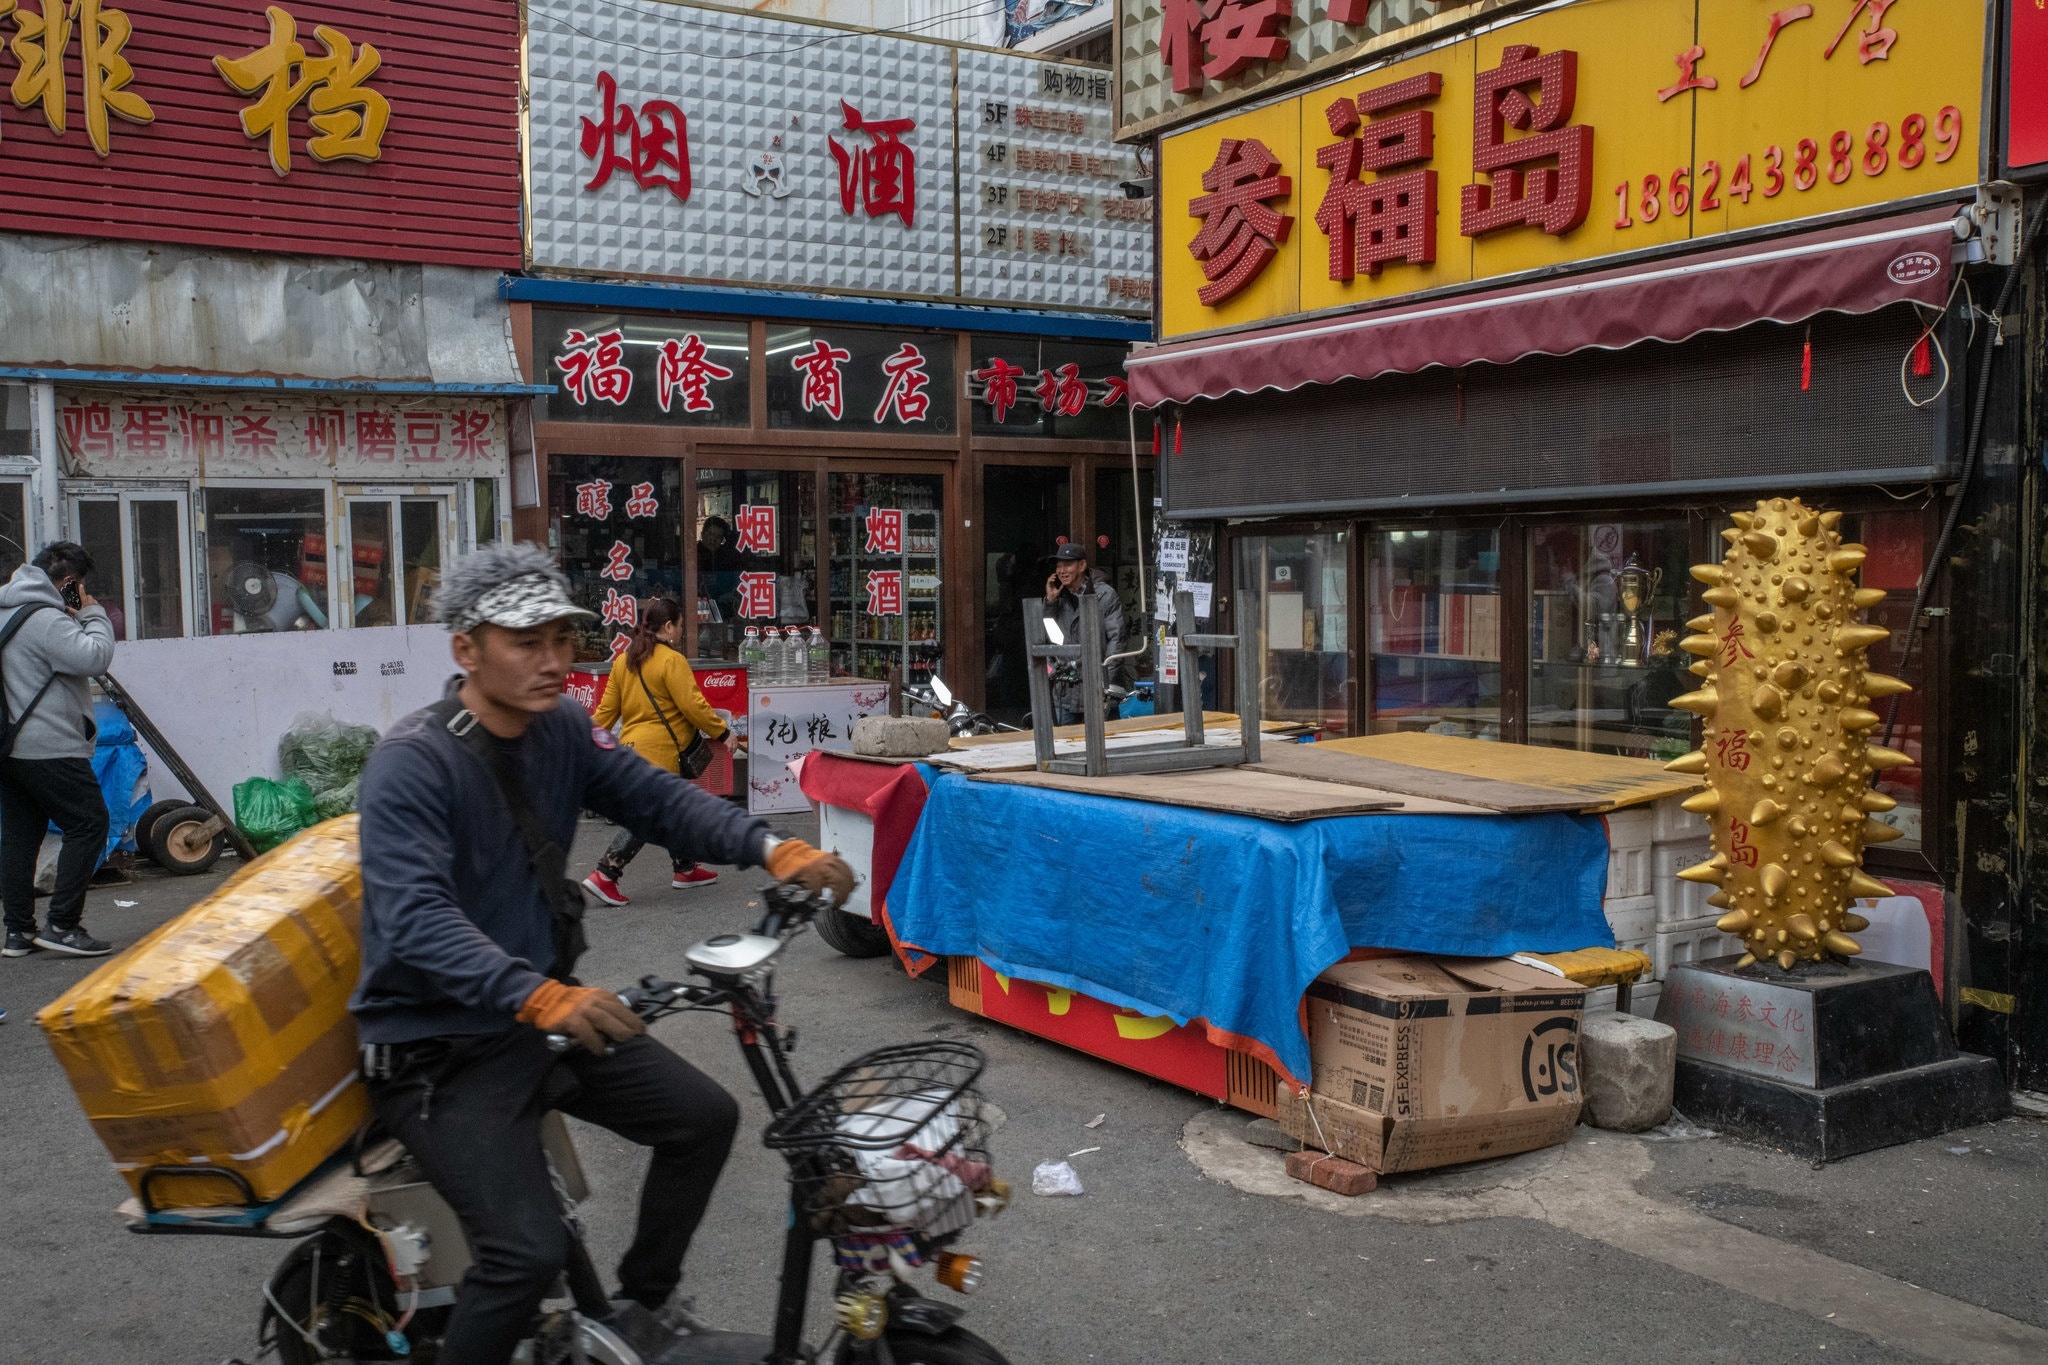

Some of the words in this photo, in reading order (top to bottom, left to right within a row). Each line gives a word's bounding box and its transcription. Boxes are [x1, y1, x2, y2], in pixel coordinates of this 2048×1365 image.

[986, 102, 1009, 123] 5F
[1043, 68, 1113, 101] 购物指
[986, 144, 1006, 162] 4F
[1187, 44, 1595, 307] 参福岛
[1613, 104, 1962, 230] 18624388889
[988, 186, 1008, 204] 3F
[987, 227, 1007, 247] 2F
[555, 327, 932, 425] 福隆商店
[63, 402, 280, 464] 鸡蛋油条
[303, 408, 494, 465] 现磨豆浆
[735, 504, 777, 619] 烟酒
[865, 506, 903, 617] 烟酒
[1716, 615, 1759, 870] 参福岛
[1396, 1025, 1411, 1090] EXPRESS
[1398, 1094, 1410, 1115] SF
